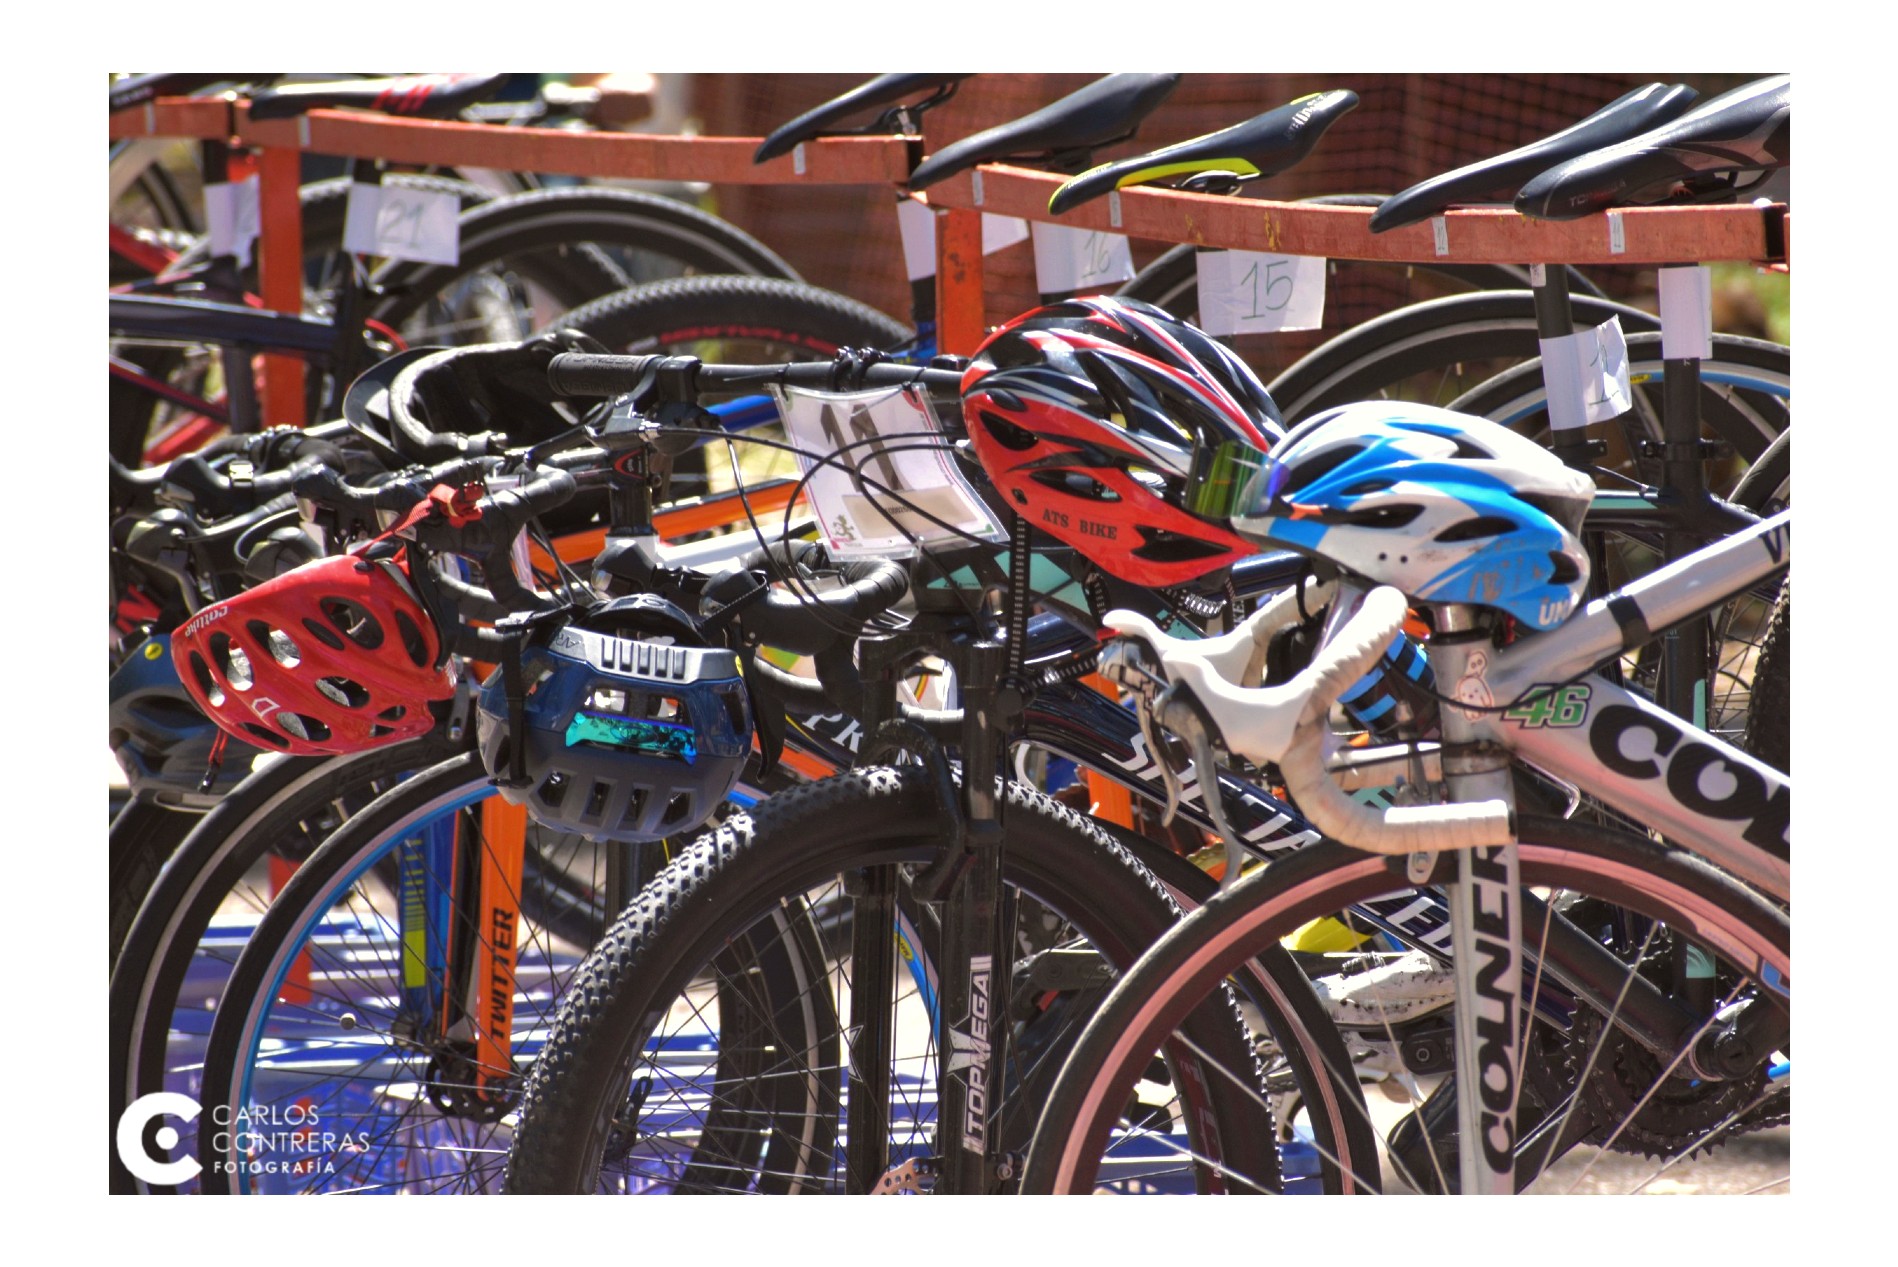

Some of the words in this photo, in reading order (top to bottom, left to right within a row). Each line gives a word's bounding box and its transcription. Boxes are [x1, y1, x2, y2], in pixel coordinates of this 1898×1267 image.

[1240, 260, 1294, 320] 15
[1043, 508, 1069, 528] ATS
[1079, 519, 1118, 540] BIKE
[1500, 682, 1593, 729] 46
[491, 907, 514, 1040] TWITTER
[967, 972, 991, 1135] TOPMEGA
